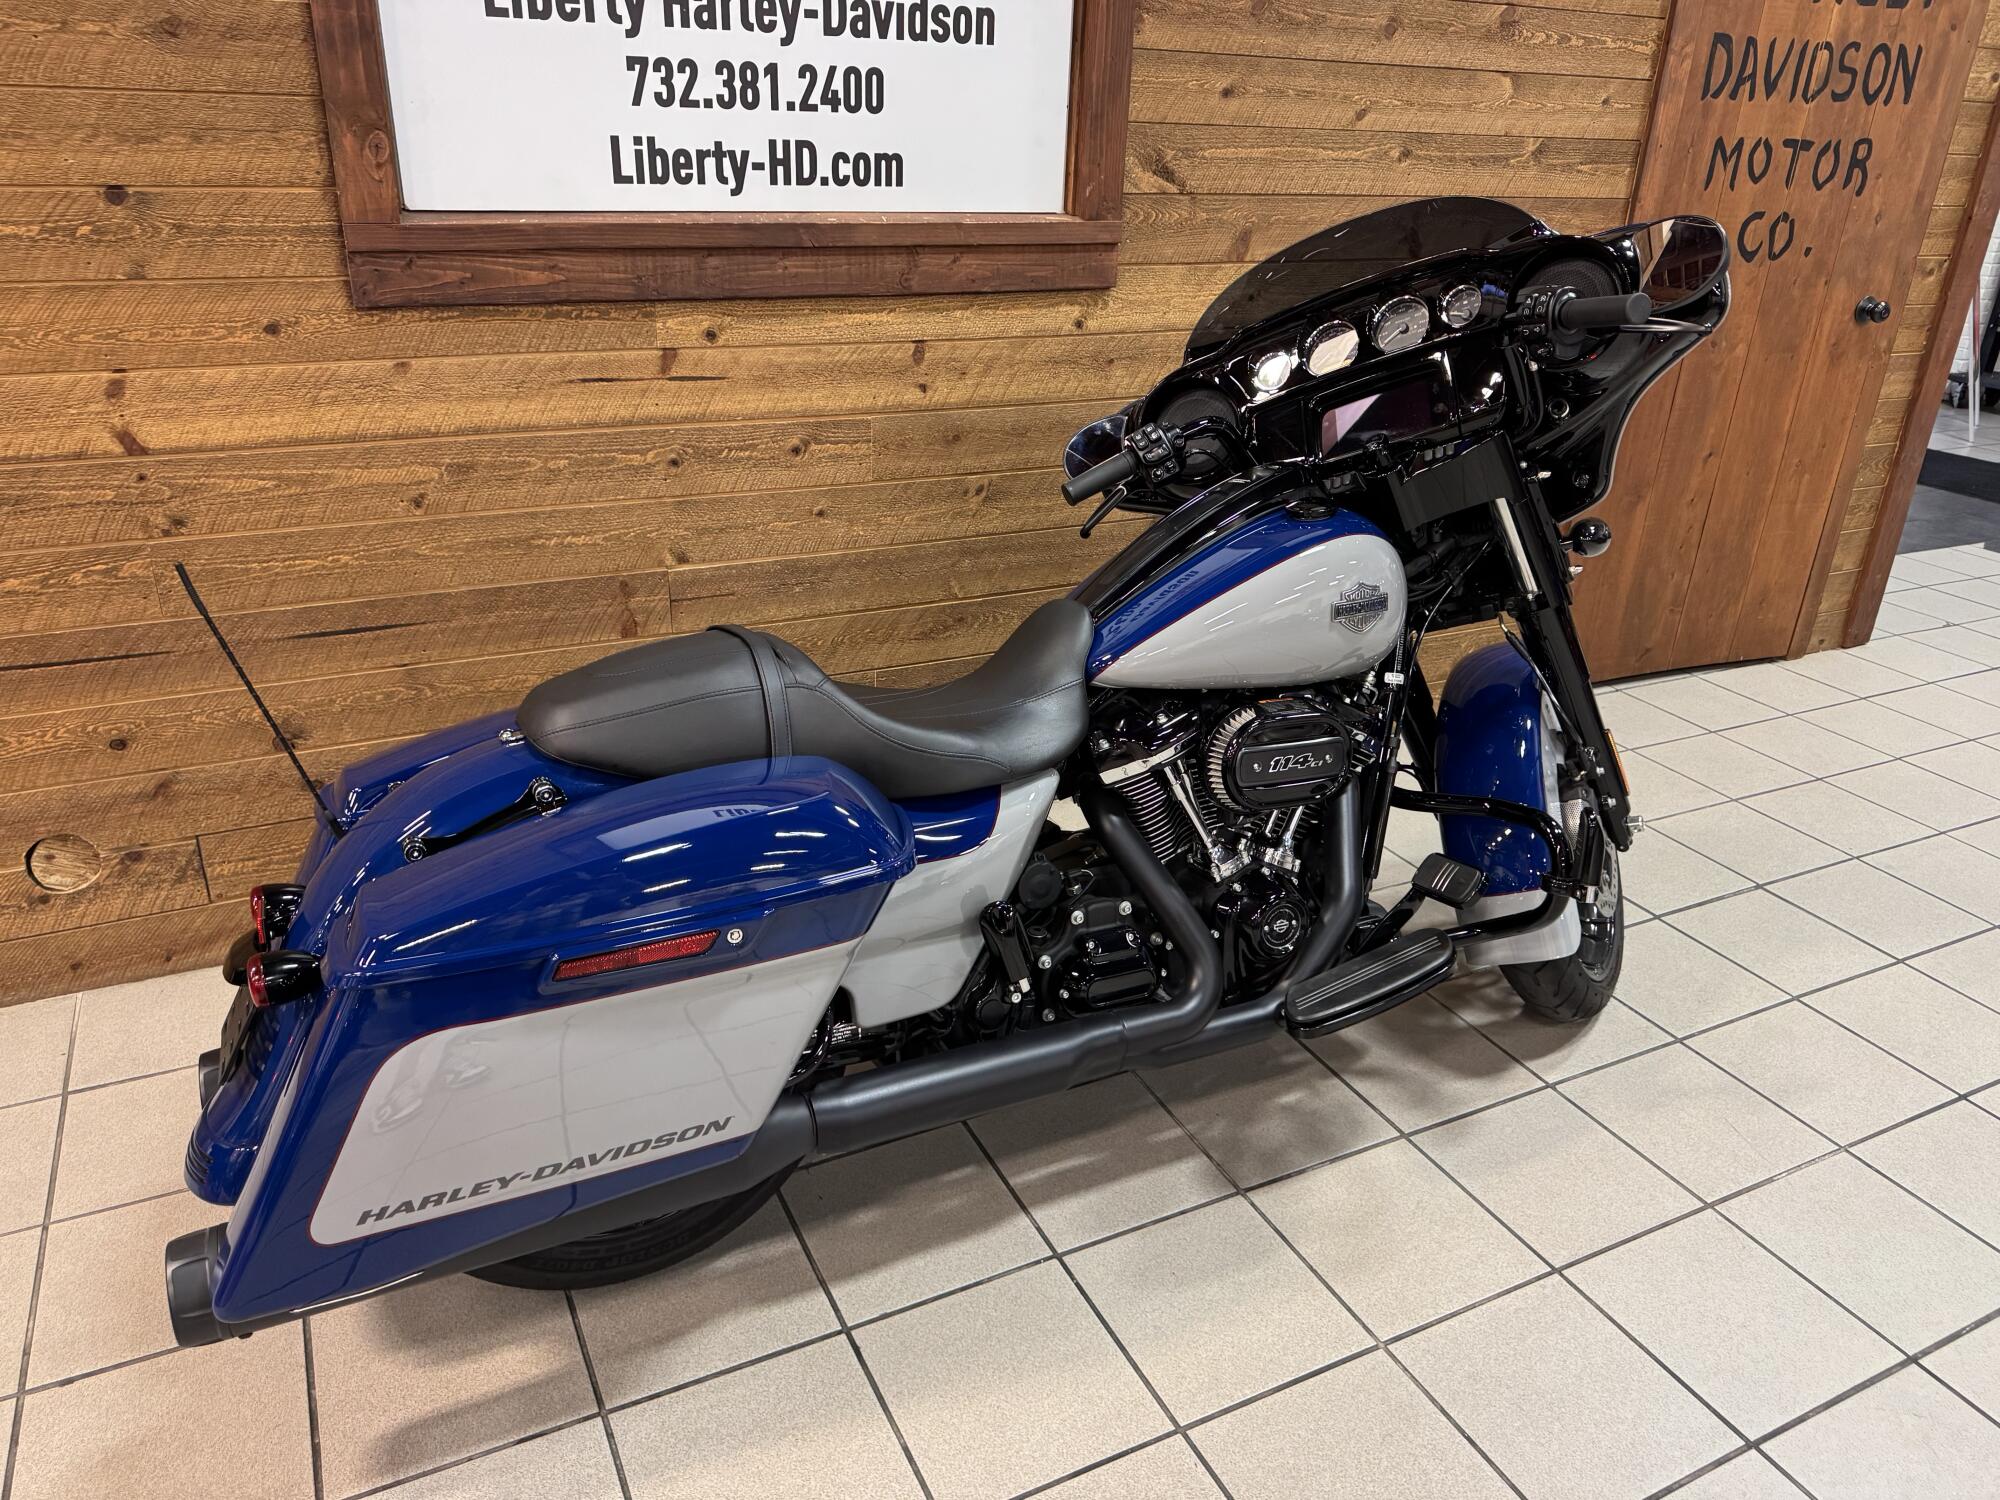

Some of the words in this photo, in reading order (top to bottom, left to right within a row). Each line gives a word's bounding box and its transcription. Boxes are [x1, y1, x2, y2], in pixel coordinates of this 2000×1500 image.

[662, 0, 996, 46] Harley-Davidson
[625, 55, 885, 115] 732.381.2400
[1701, 31, 1923, 107] DAVIDSON
[609, 135, 905, 196] Liberty-HD.com
[1704, 135, 1873, 197] MOTOR
[1737, 210, 1813, 263] CO.
[356, 1115, 735, 1227] HARLEY-DAVIDSON
